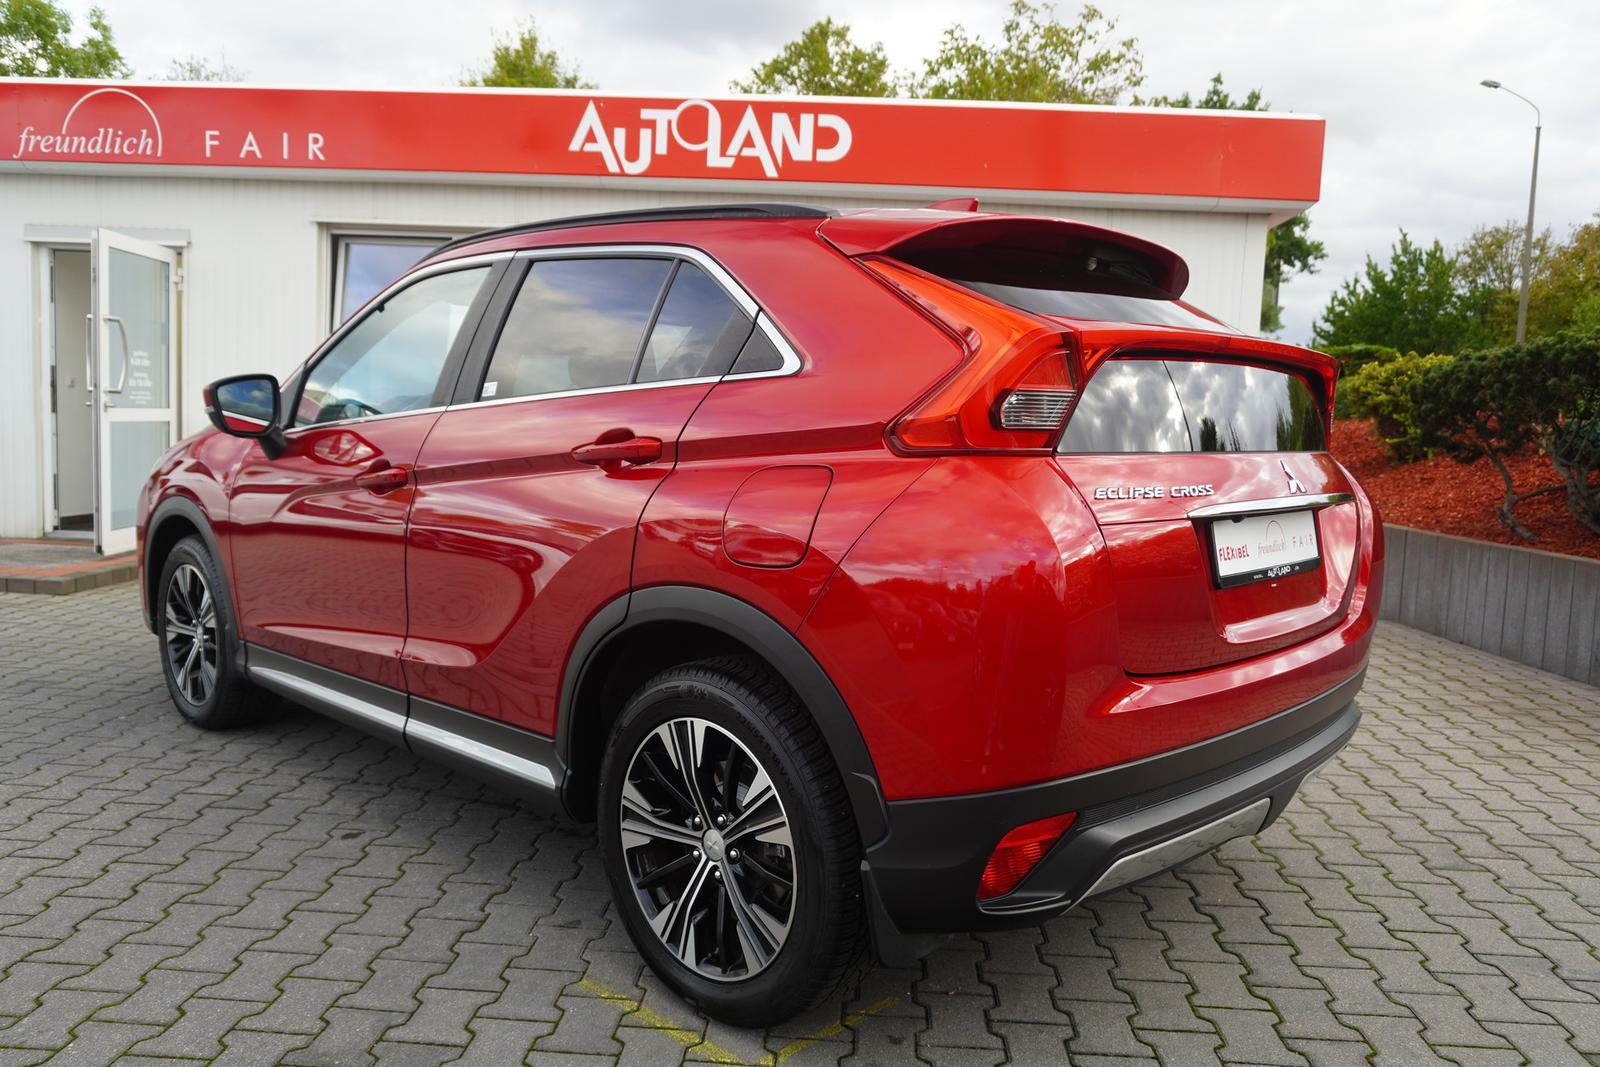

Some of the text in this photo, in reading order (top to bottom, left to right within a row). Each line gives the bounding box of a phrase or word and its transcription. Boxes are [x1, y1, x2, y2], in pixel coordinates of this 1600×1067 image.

[13, 127, 326, 161] freundlich FAIR
[568, 98, 853, 178] AUTOLAND
[1094, 484, 1215, 500] ECLIPSE CROSS
[1218, 543, 1250, 562] FLEXIBEL
